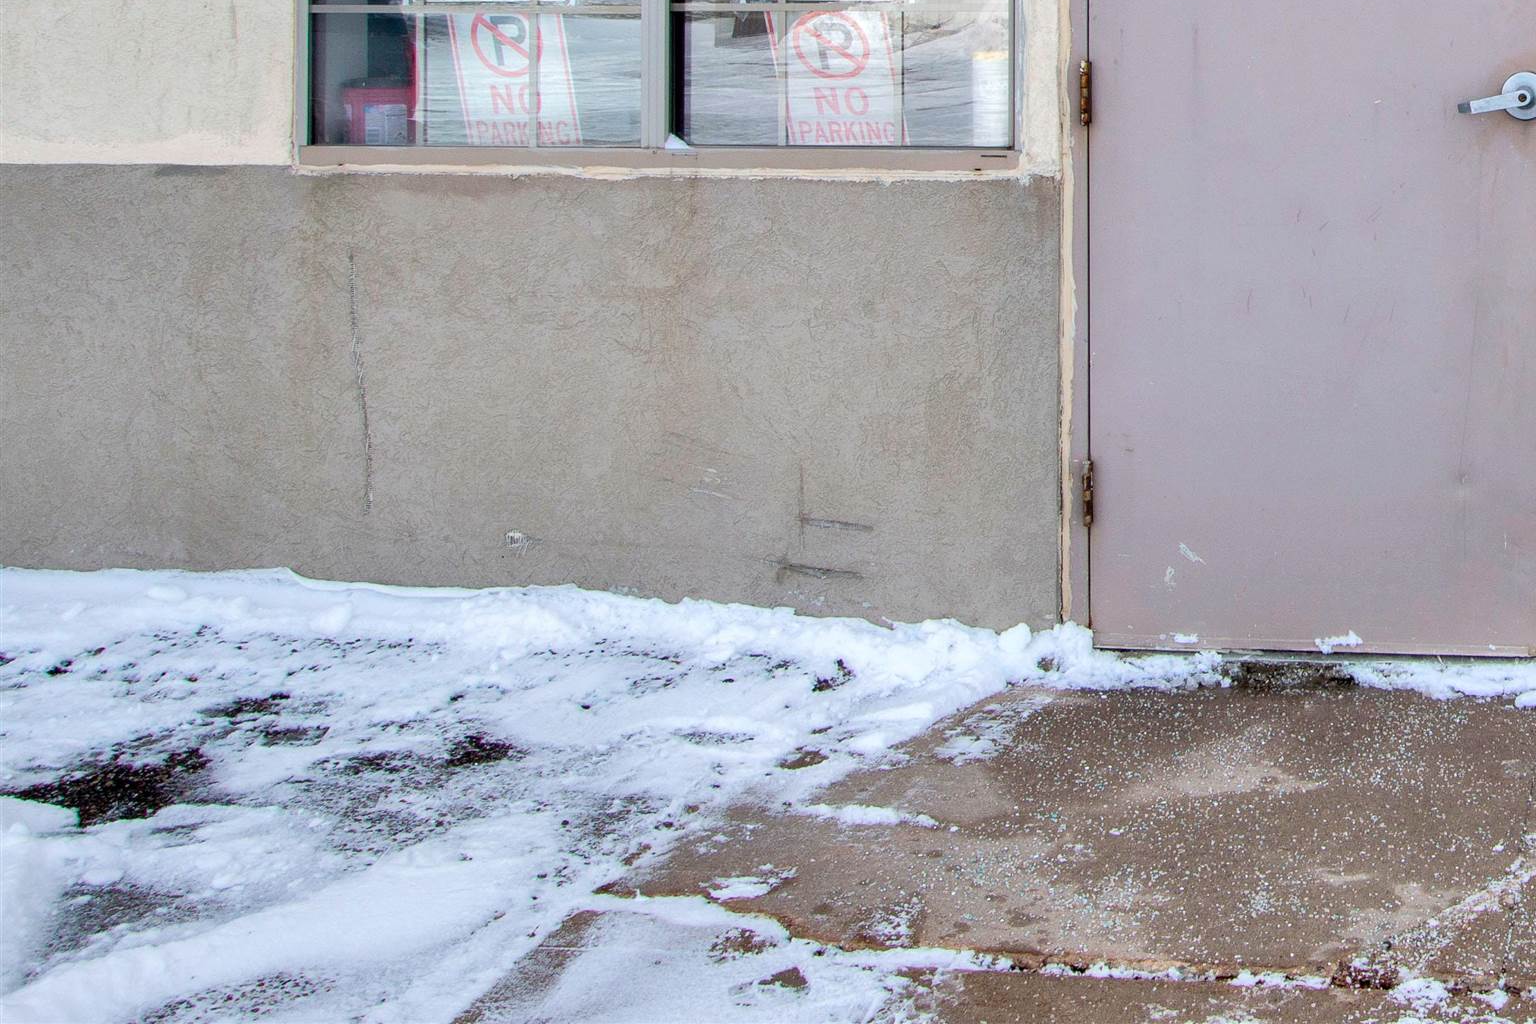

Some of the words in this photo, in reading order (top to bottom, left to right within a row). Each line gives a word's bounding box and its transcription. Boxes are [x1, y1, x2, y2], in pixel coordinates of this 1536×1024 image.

[489, 83, 542, 115] NO
[813, 85, 870, 116] NO
[475, 119, 572, 145] PARKNG
[798, 120, 897, 144] PARKING
